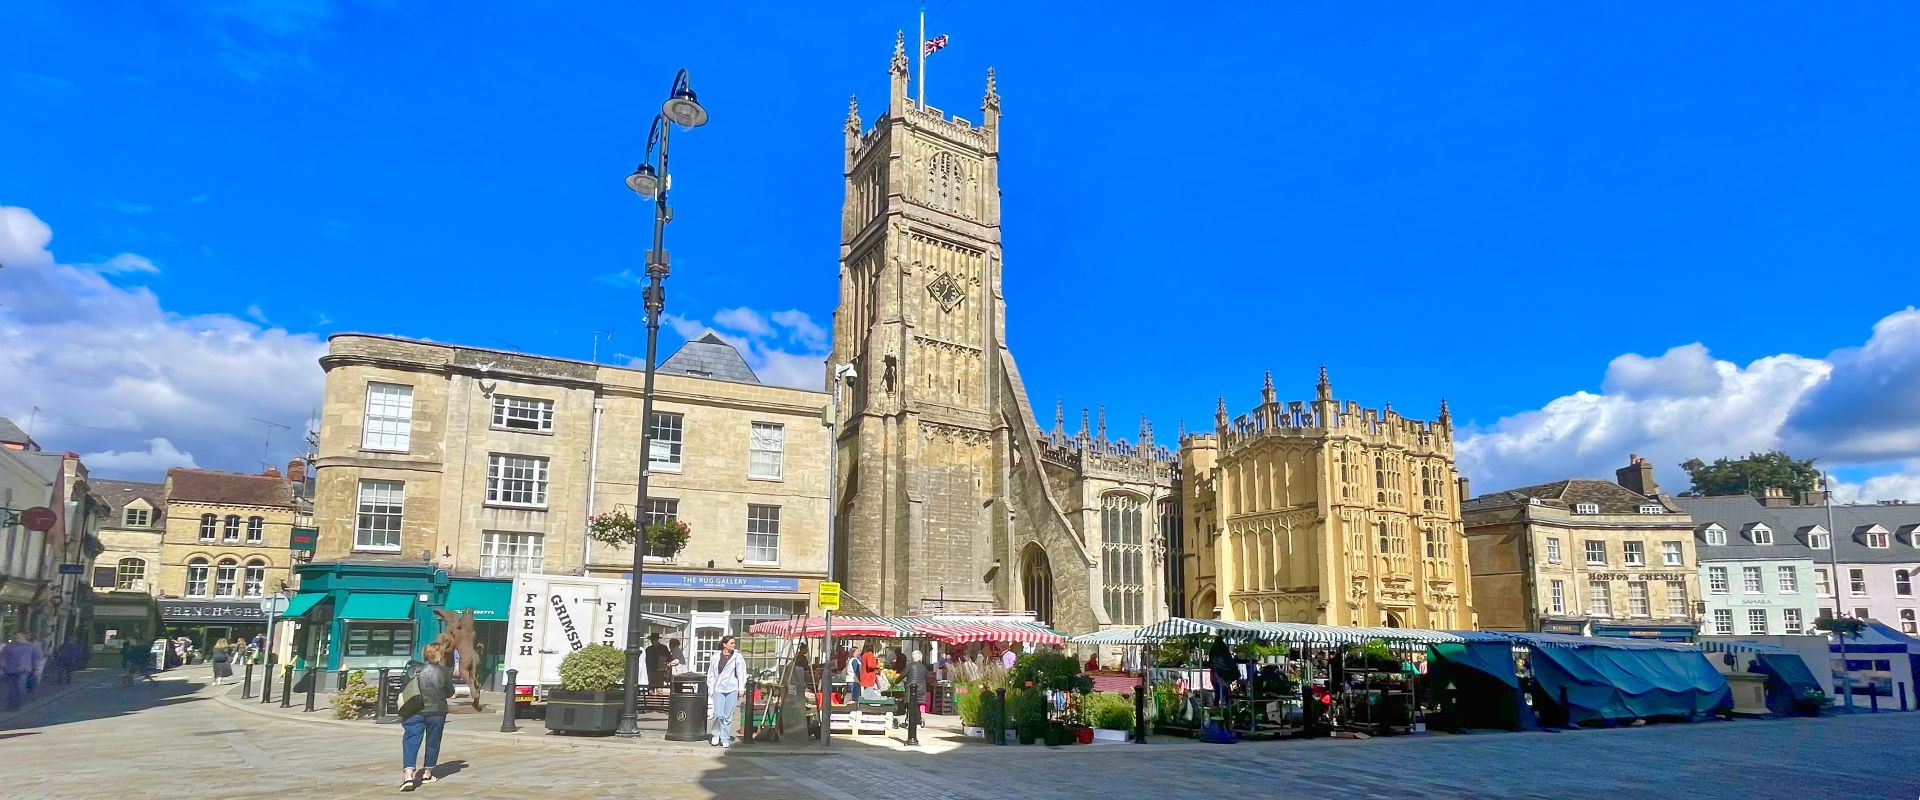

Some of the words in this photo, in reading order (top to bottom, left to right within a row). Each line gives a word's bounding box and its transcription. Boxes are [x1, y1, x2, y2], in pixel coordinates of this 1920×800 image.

[682, 576, 697, 584] THE
[1588, 572, 1629, 581] HORTON
[1638, 573, 1686, 581] CHEMIST
[163, 606, 222, 616] FRENCH
[519, 593, 537, 656] FRESH
[551, 594, 583, 652] GRIMSB
